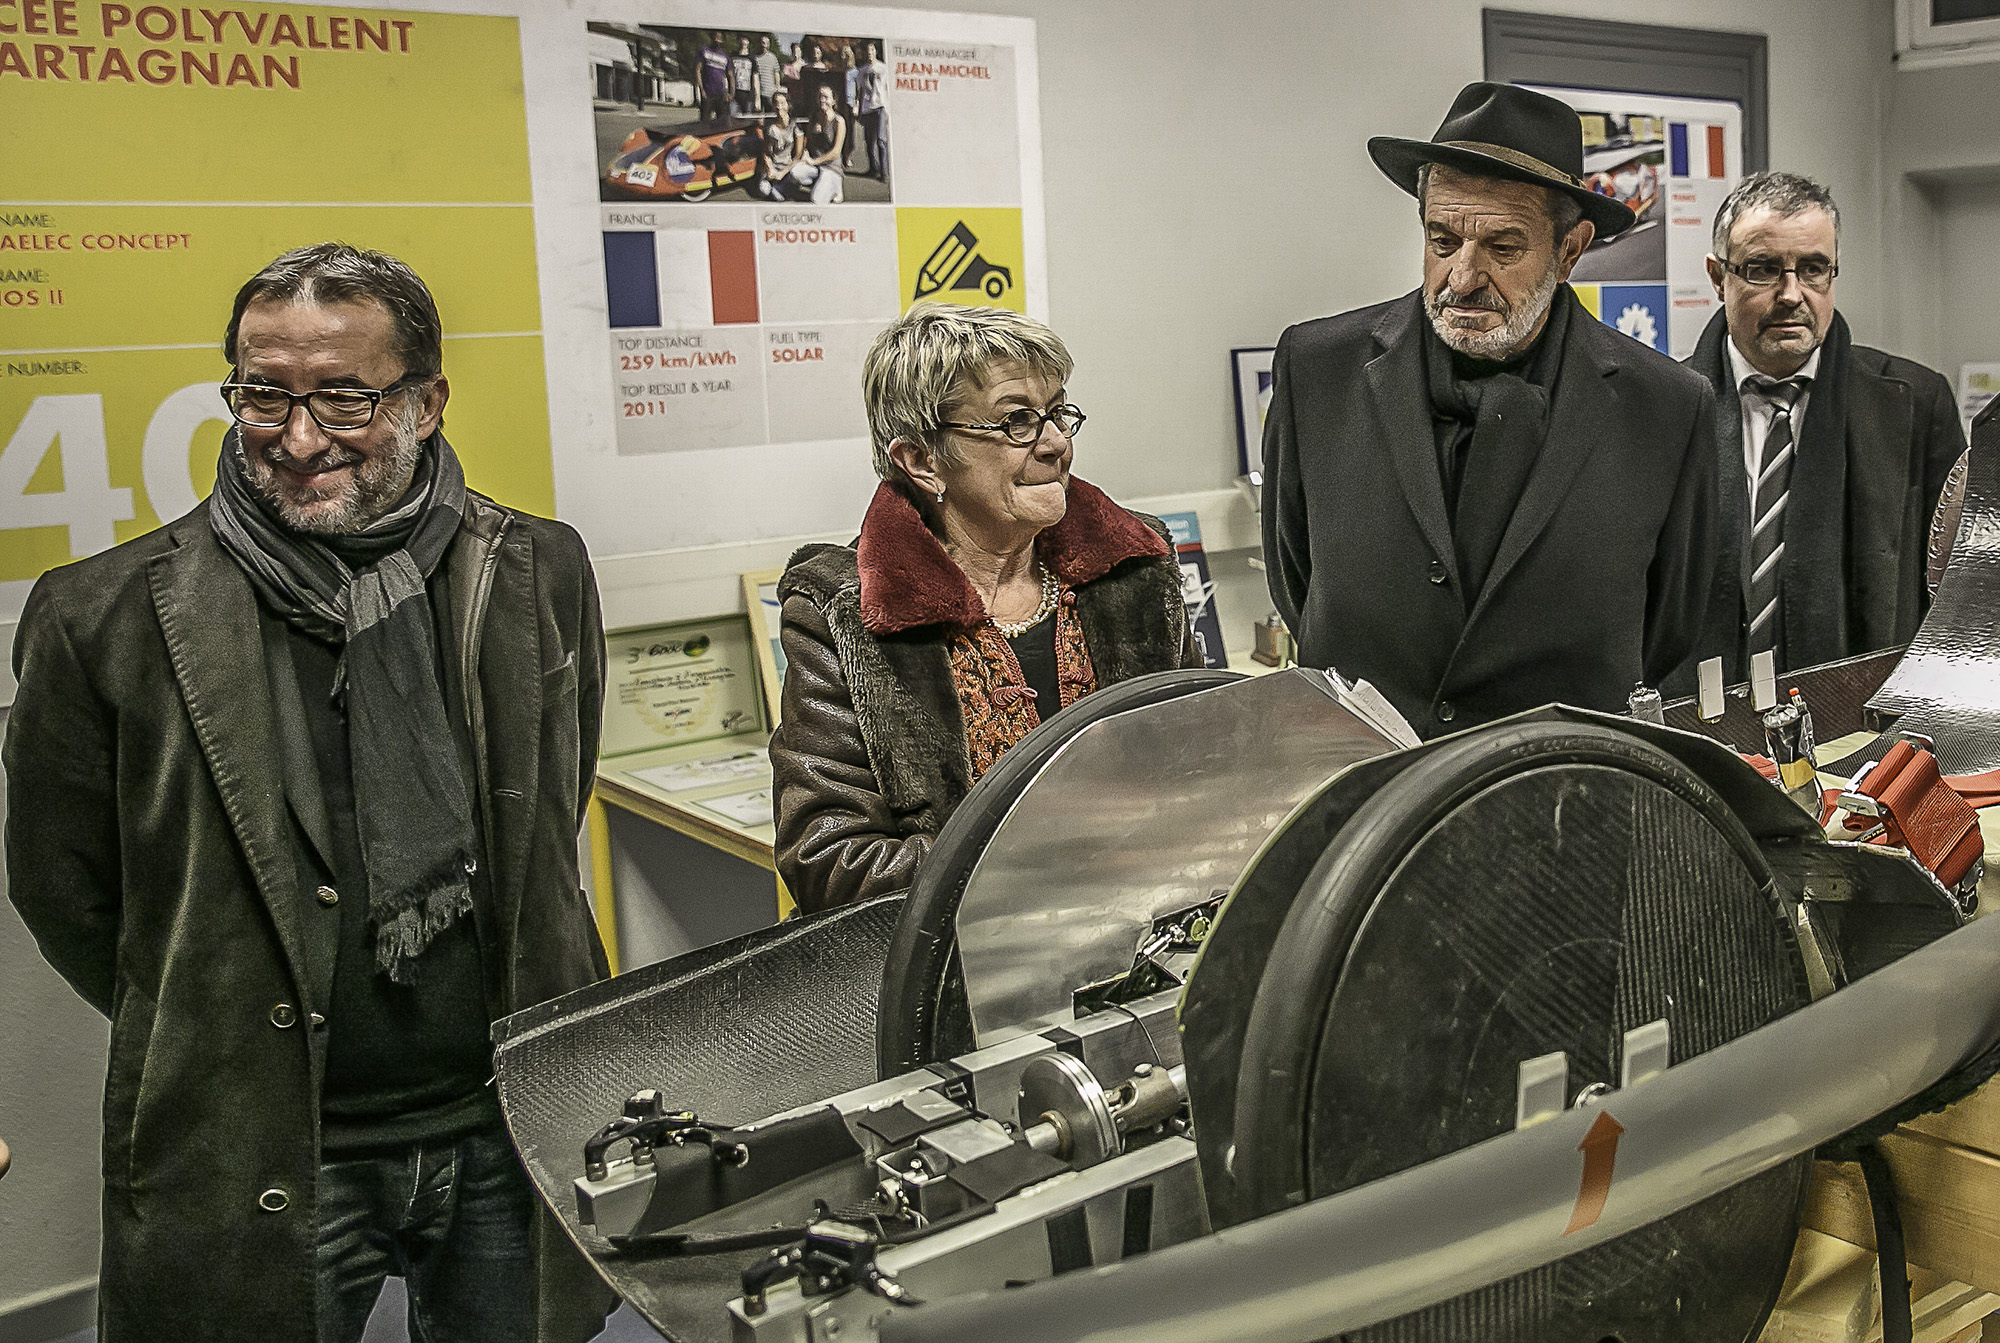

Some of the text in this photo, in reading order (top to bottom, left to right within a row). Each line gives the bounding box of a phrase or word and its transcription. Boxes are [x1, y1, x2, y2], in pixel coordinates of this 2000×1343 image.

[0, 0, 415, 54] CEE POLYVALENT
[0, 42, 301, 90] ARTAGNAN
[895, 62, 991, 80] JEAN-MICHEL
[895, 78, 939, 92] MELET
[609, 214, 657, 226] FRANCE
[763, 213, 823, 225] CATEGORY
[0, 233, 192, 250] AELEC CONCEPT
[764, 229, 856, 243] PROTOTYPE
[49, 289, 64, 305] II
[618, 336, 703, 351] TOP DISTANCE
[620, 350, 737, 371] 259 km/kWh
[772, 347, 825, 363] SOLAR
[621, 385, 645, 397] TOP
[623, 401, 667, 418] 2011
